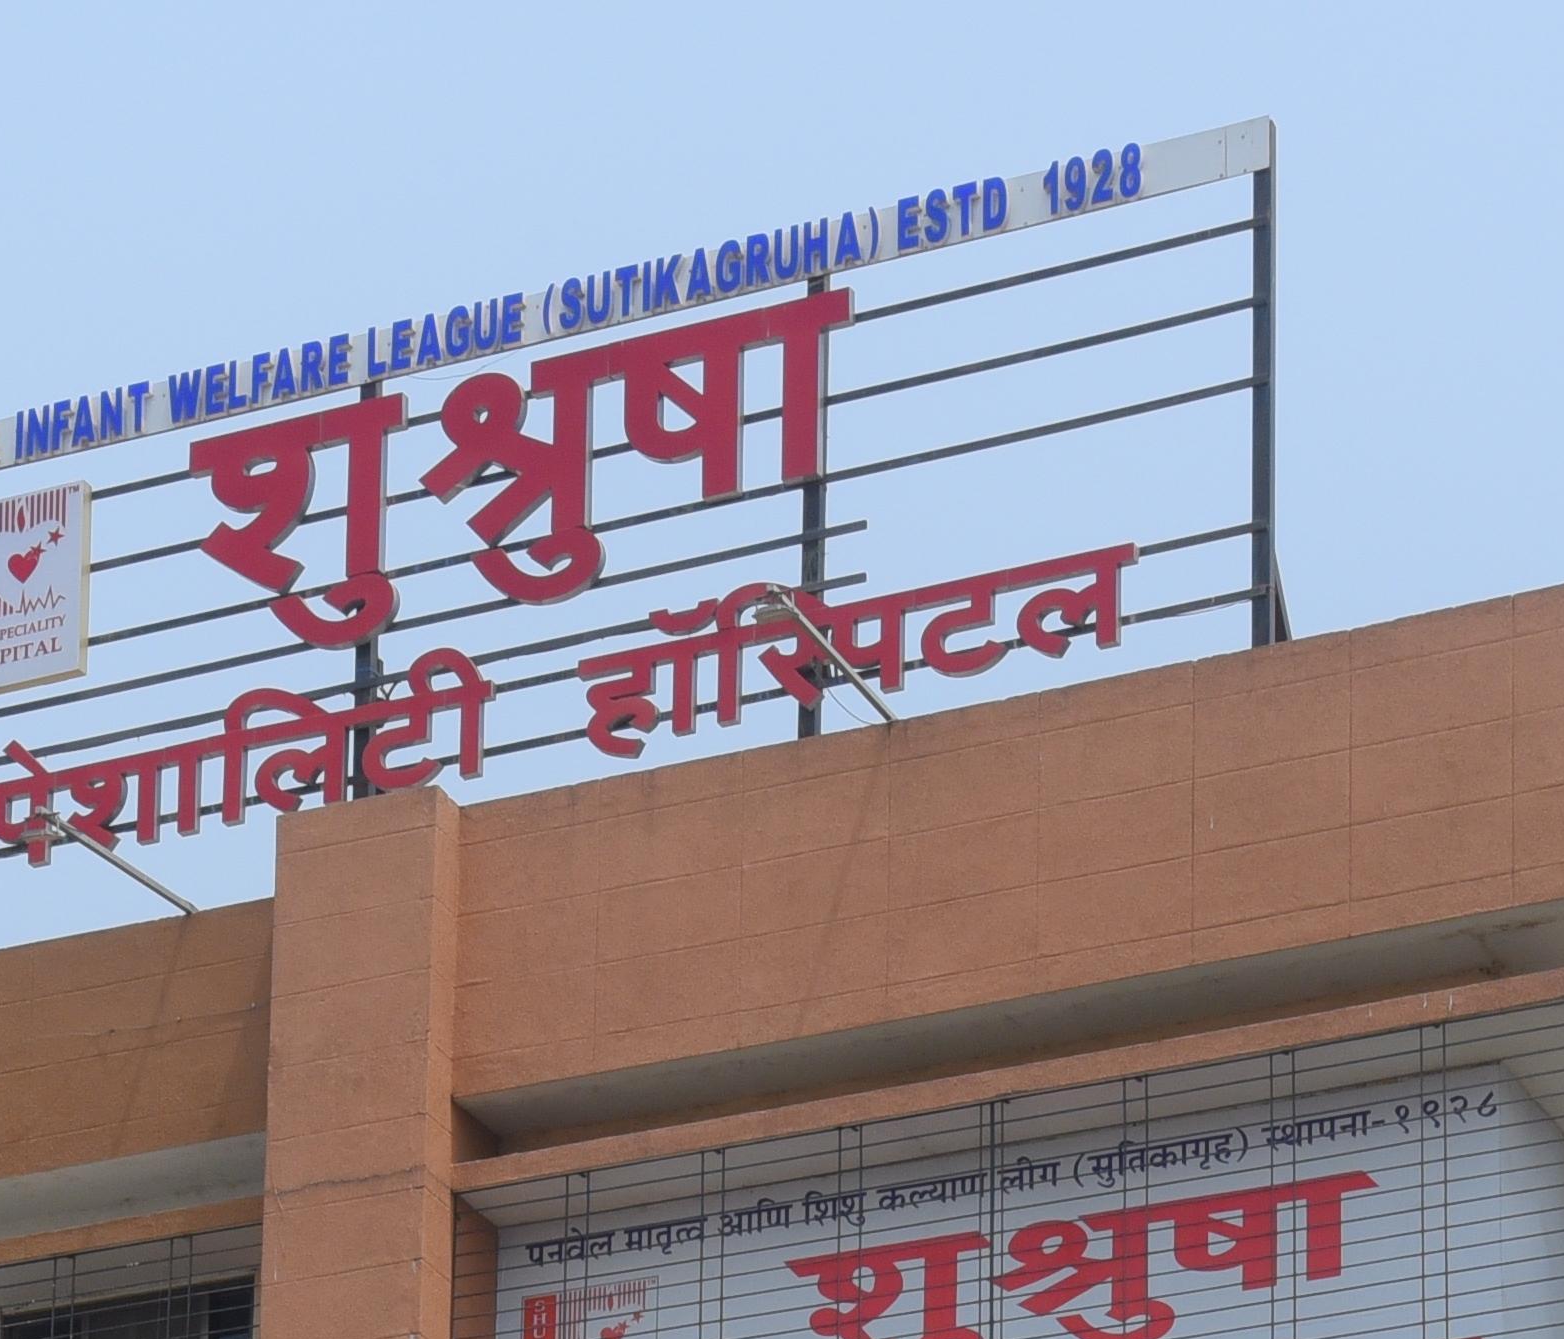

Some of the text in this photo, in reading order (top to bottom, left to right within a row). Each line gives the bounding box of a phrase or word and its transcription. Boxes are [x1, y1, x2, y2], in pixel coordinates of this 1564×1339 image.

[15, 383, 148, 460] INFANT
[168, 333, 350, 424] WELFARE
[367, 292, 524, 378] LEAGUE
[542, 206, 879, 334] (SUTIKAGRUHA)
[897, 177, 1007, 250] ESTD
[1044, 143, 1142, 214] 1928
[578, 542, 1138, 759] हॉस्पिटल
[526, 1227, 614, 1267] पनवेल
[718, 1196, 791, 1237] आणि
[803, 1190, 866, 1227] शिशु
[876, 1173, 988, 1212] कल्याण
